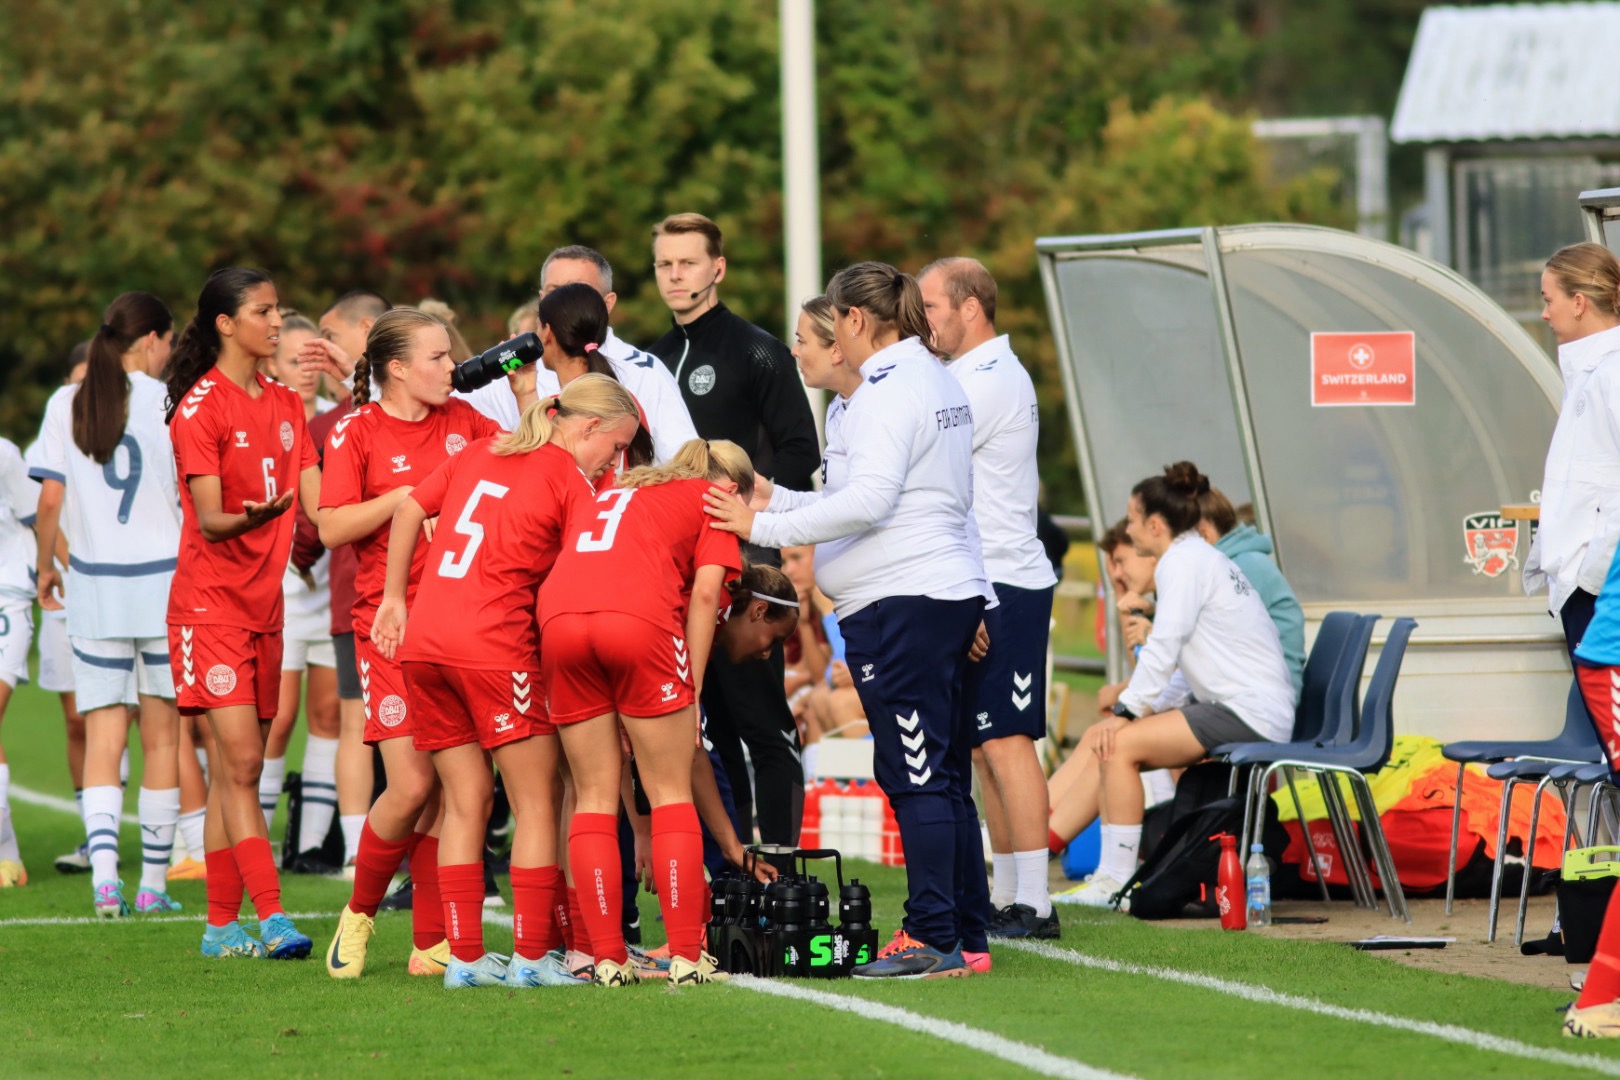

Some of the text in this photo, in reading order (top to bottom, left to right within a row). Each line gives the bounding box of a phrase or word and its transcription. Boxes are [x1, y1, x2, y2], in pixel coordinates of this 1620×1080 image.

[1322, 373, 1406, 385] SWITZERLAND
[102, 433, 143, 524] 9
[262, 457, 277, 503] 6
[438, 479, 510, 579] 5
[576, 487, 638, 553] 3
[594, 868, 608, 916] DANMARK
[670, 859, 678, 909] DANMARK
[810, 935, 831, 966] S
[834, 934, 843, 966] SPORT
